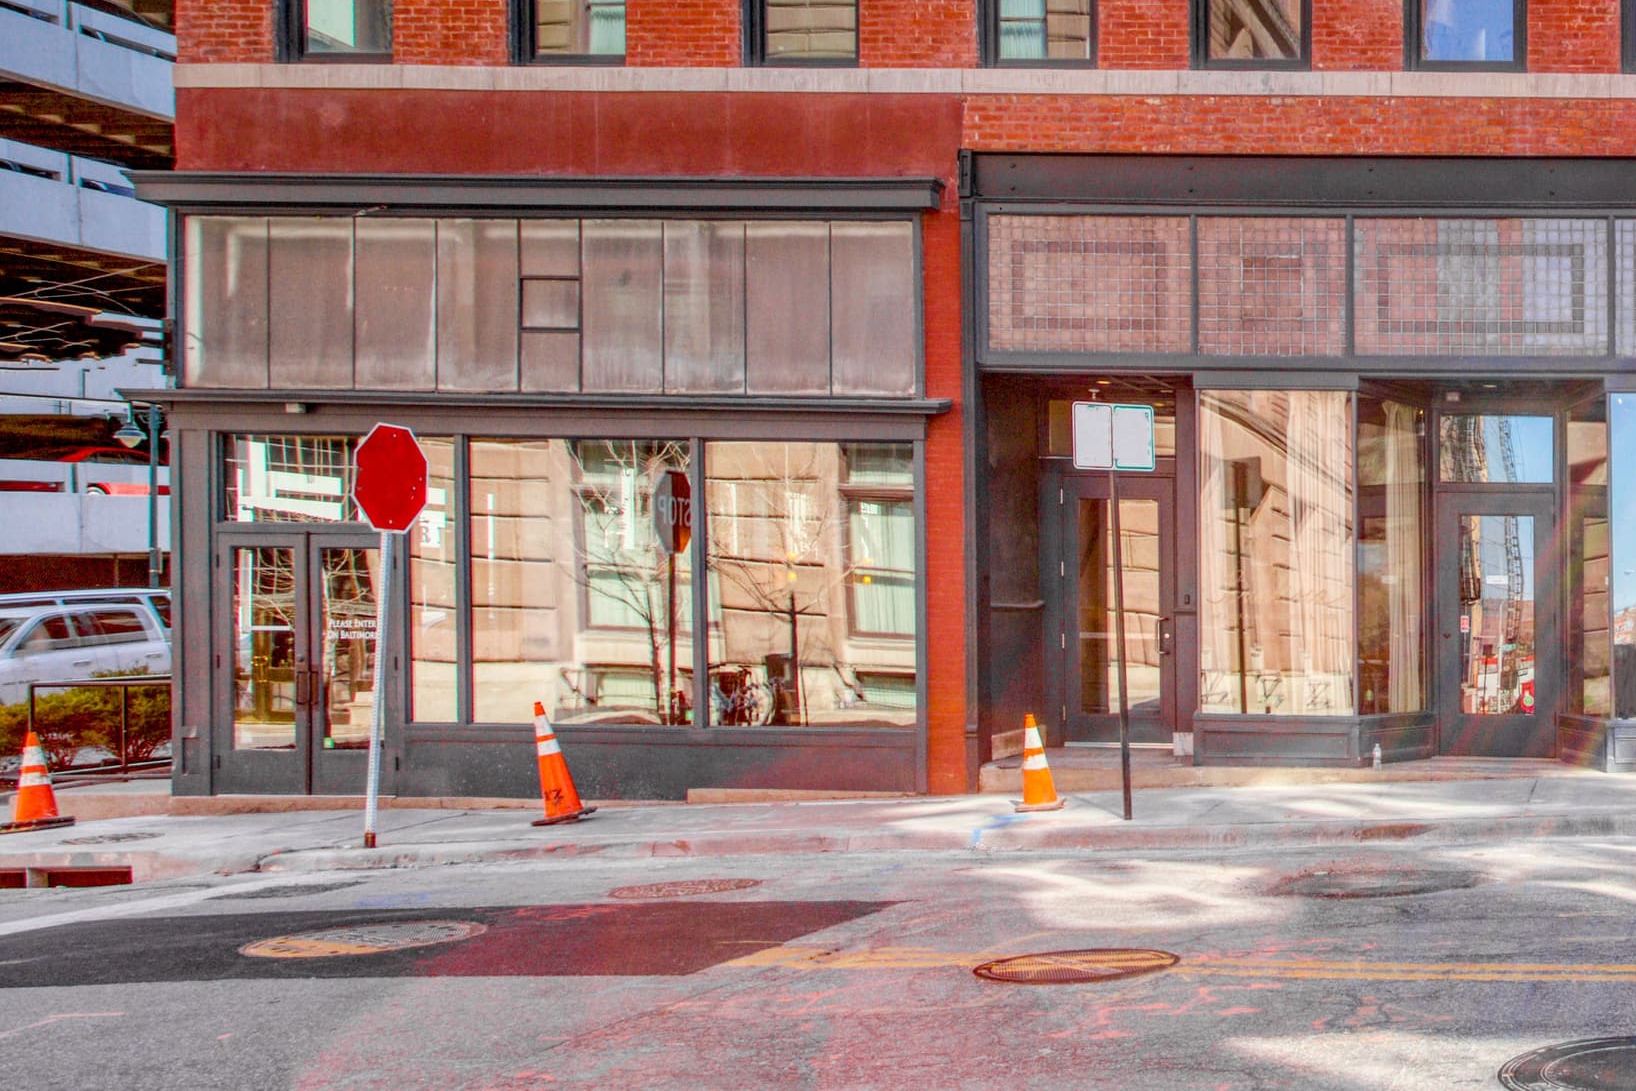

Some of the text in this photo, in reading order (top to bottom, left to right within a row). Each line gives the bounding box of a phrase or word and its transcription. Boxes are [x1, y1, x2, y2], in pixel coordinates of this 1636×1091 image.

[328, 618, 377, 628] PLEASE ENTER
[328, 629, 377, 640] ON BALTIMOR
